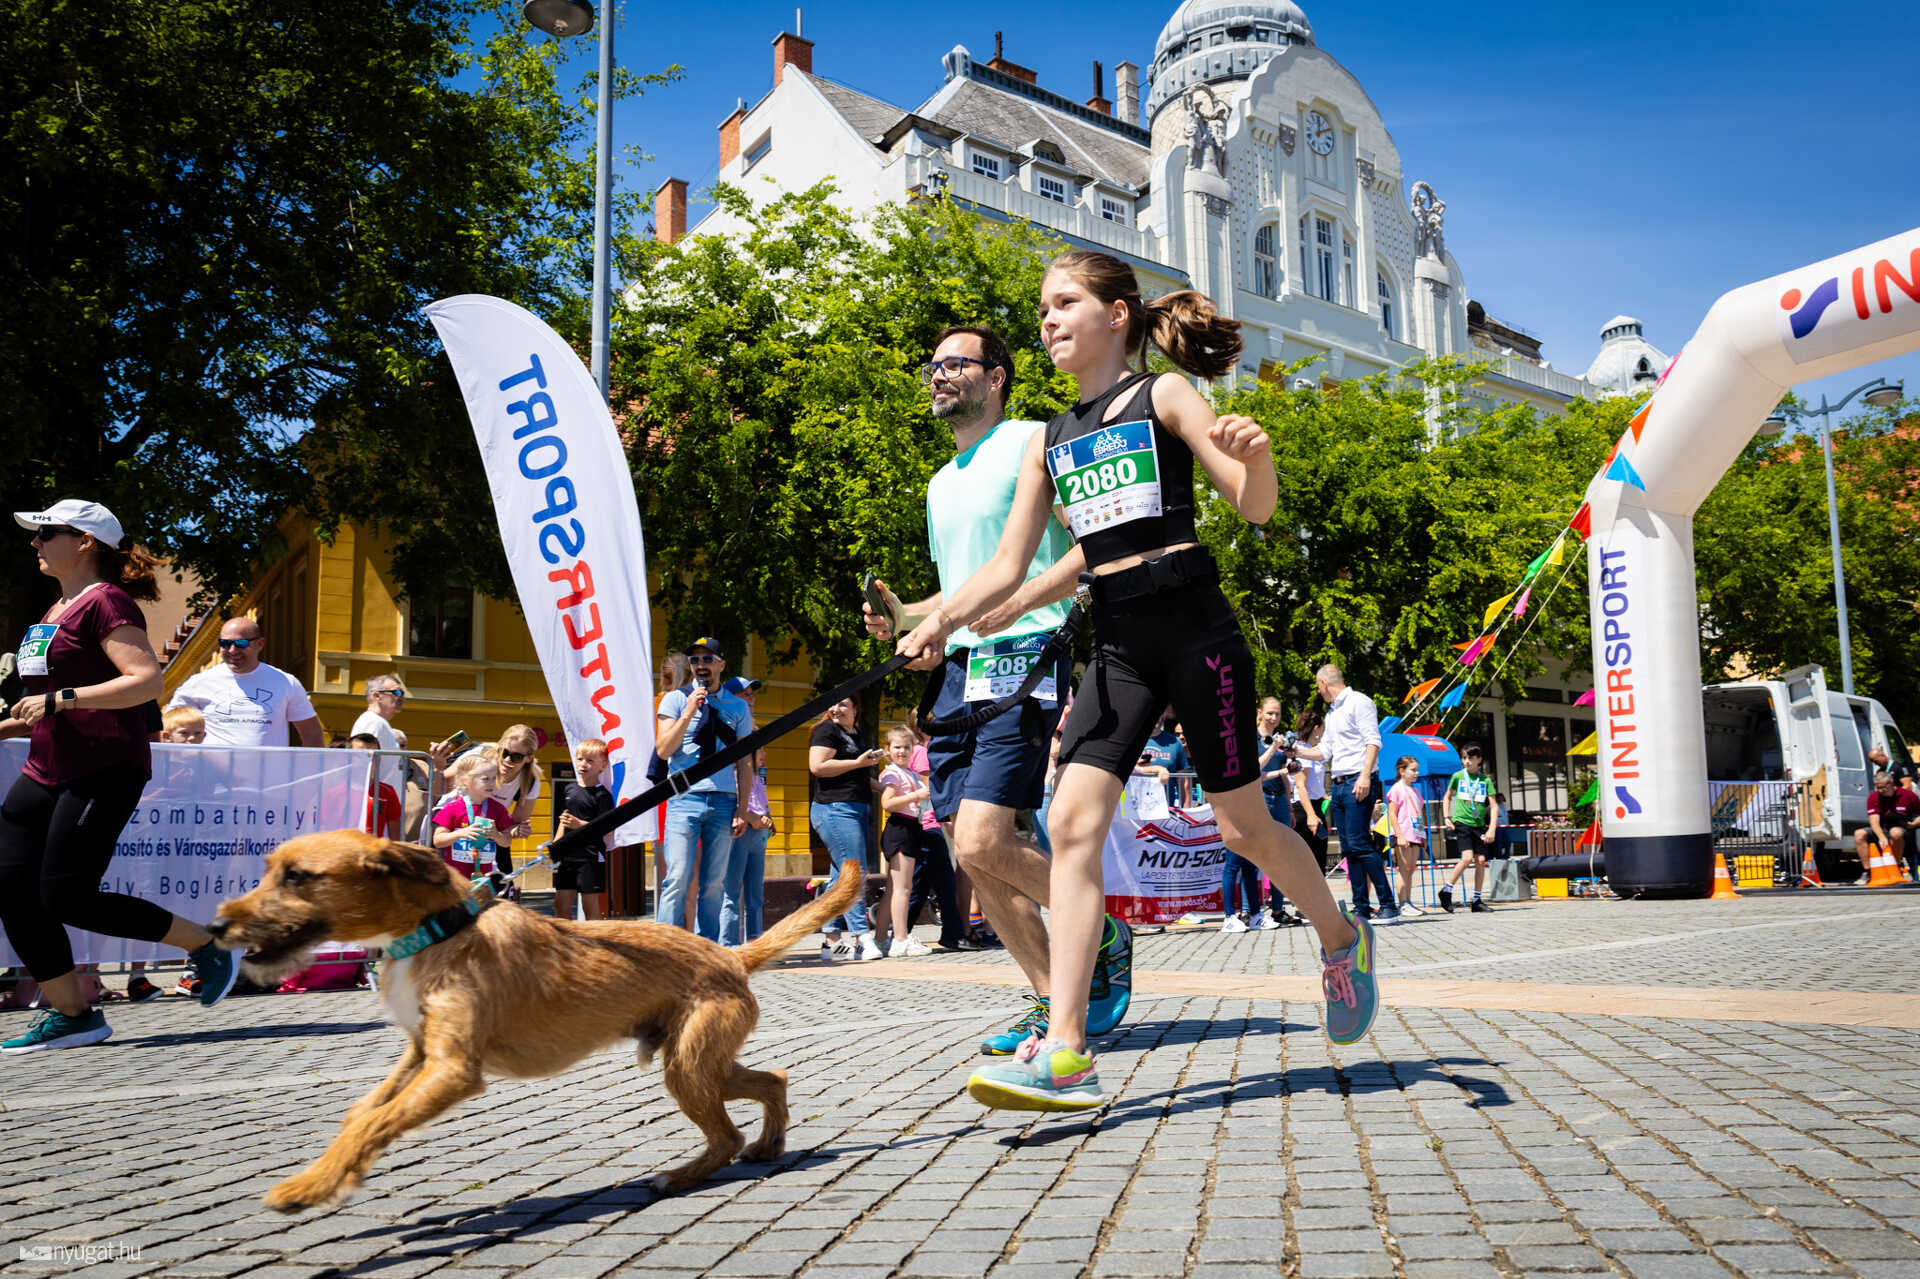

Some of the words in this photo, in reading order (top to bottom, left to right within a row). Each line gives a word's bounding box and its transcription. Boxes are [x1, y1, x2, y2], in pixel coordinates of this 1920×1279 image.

[1852, 247, 1920, 320] IN
[1065, 457, 1138, 503] 2080
[1599, 546, 1640, 780] INTERSPORT
[1216, 664, 1240, 778] bekkin
[130, 804, 318, 830] zombathelyi
[113, 837, 153, 857] nosító
[156, 837, 171, 857] és
[174, 836, 284, 861] Városgazdálkodá
